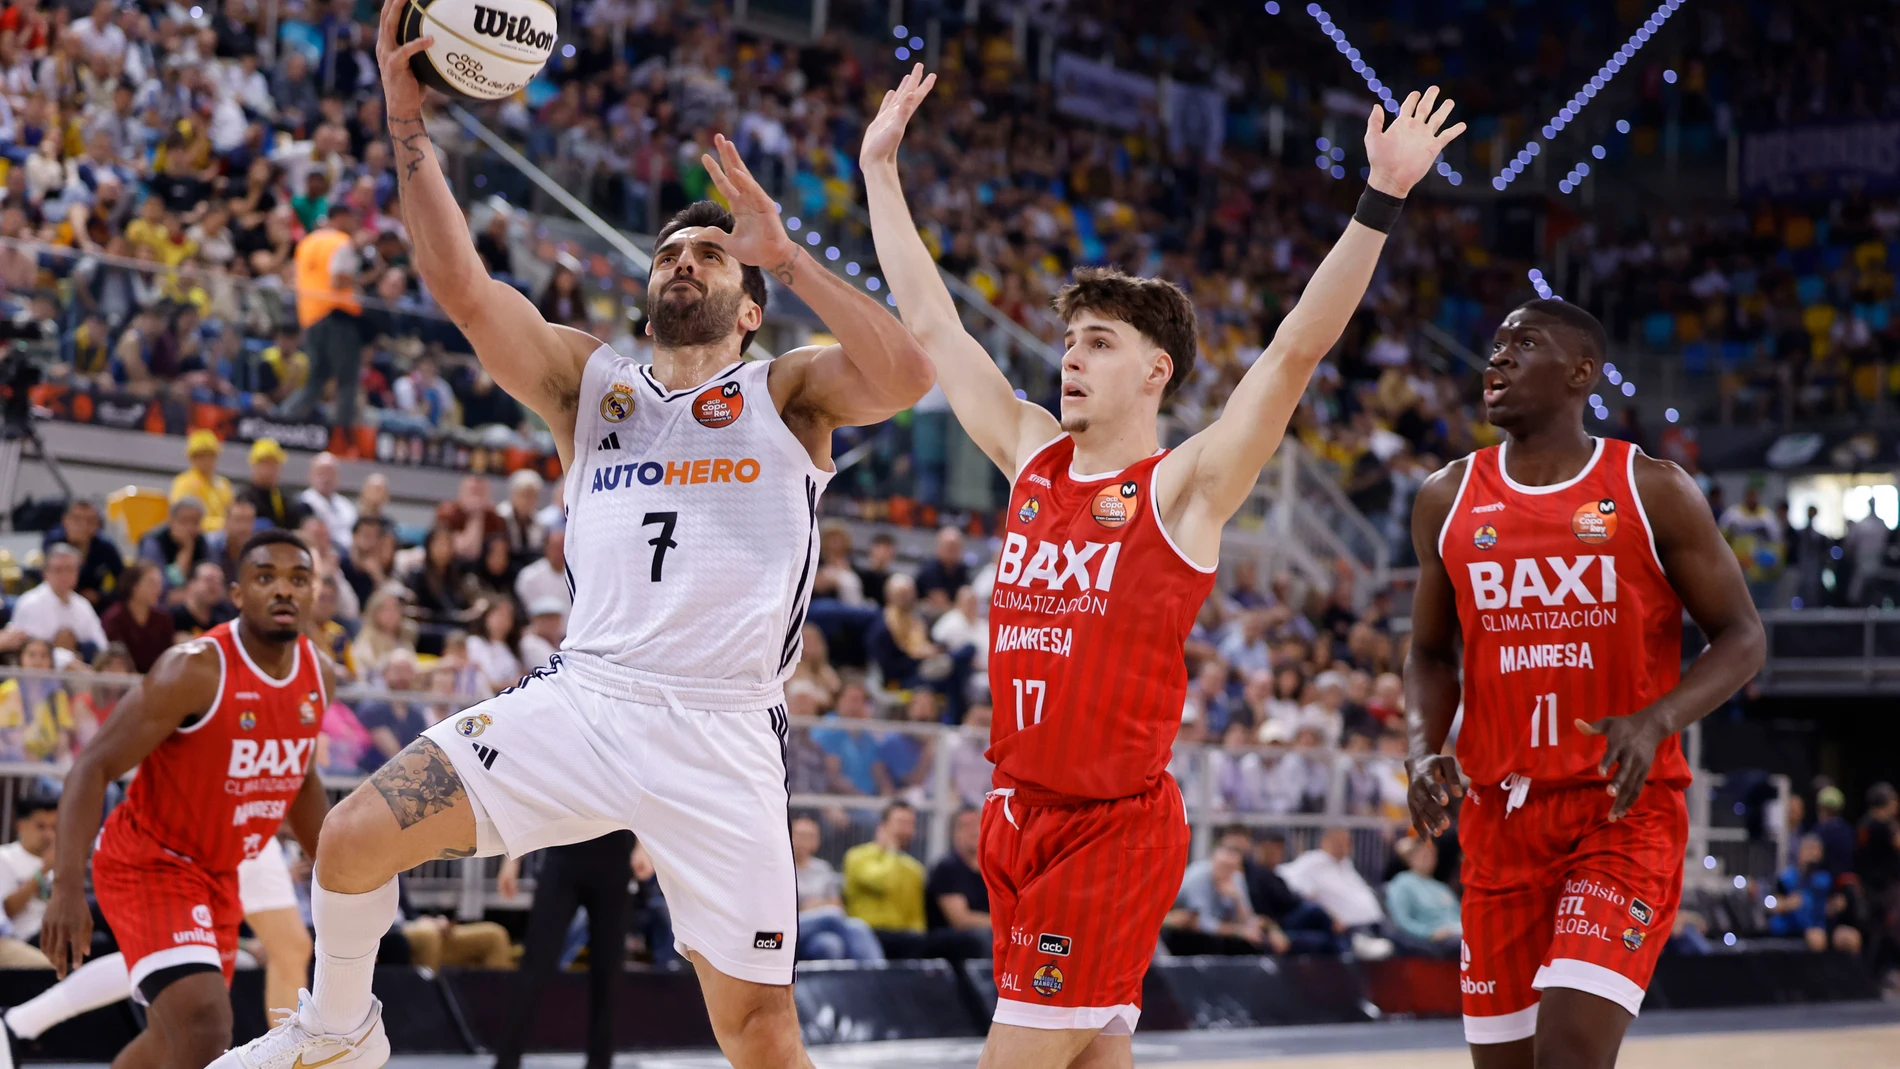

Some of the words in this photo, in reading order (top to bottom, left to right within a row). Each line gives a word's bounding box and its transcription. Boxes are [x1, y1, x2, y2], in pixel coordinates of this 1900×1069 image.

[474, 4, 553, 52] Wilson
[446, 52, 487, 84] Copa
[461, 54, 483, 71] acb
[701, 403, 727, 411] Copa
[714, 409, 731, 417] Rey
[591, 458, 761, 494] AUTOHERO
[1100, 501, 1123, 509] Copa
[1110, 509, 1125, 517] Rey
[1579, 517, 1603, 525] Copa
[641, 511, 678, 582] 7
[998, 531, 1122, 592] BAXI
[1466, 555, 1617, 610] BAXI
[1481, 606, 1616, 632] CLIMATIZACIÓN
[994, 624, 1073, 657] MANRESA
[1500, 642, 1594, 674] MANRESA
[1012, 678, 1046, 731] 17
[1530, 692, 1558, 747] 11
[1563, 879, 1625, 906] Adbisio
[1558, 895, 1585, 916] ETL
[1631, 906, 1646, 921] acb
[1555, 917, 1612, 942] GLOBAL
[756, 938, 777, 949] acb
[1041, 942, 1063, 953] acb
[1033, 979, 1062, 990] MANRESA
